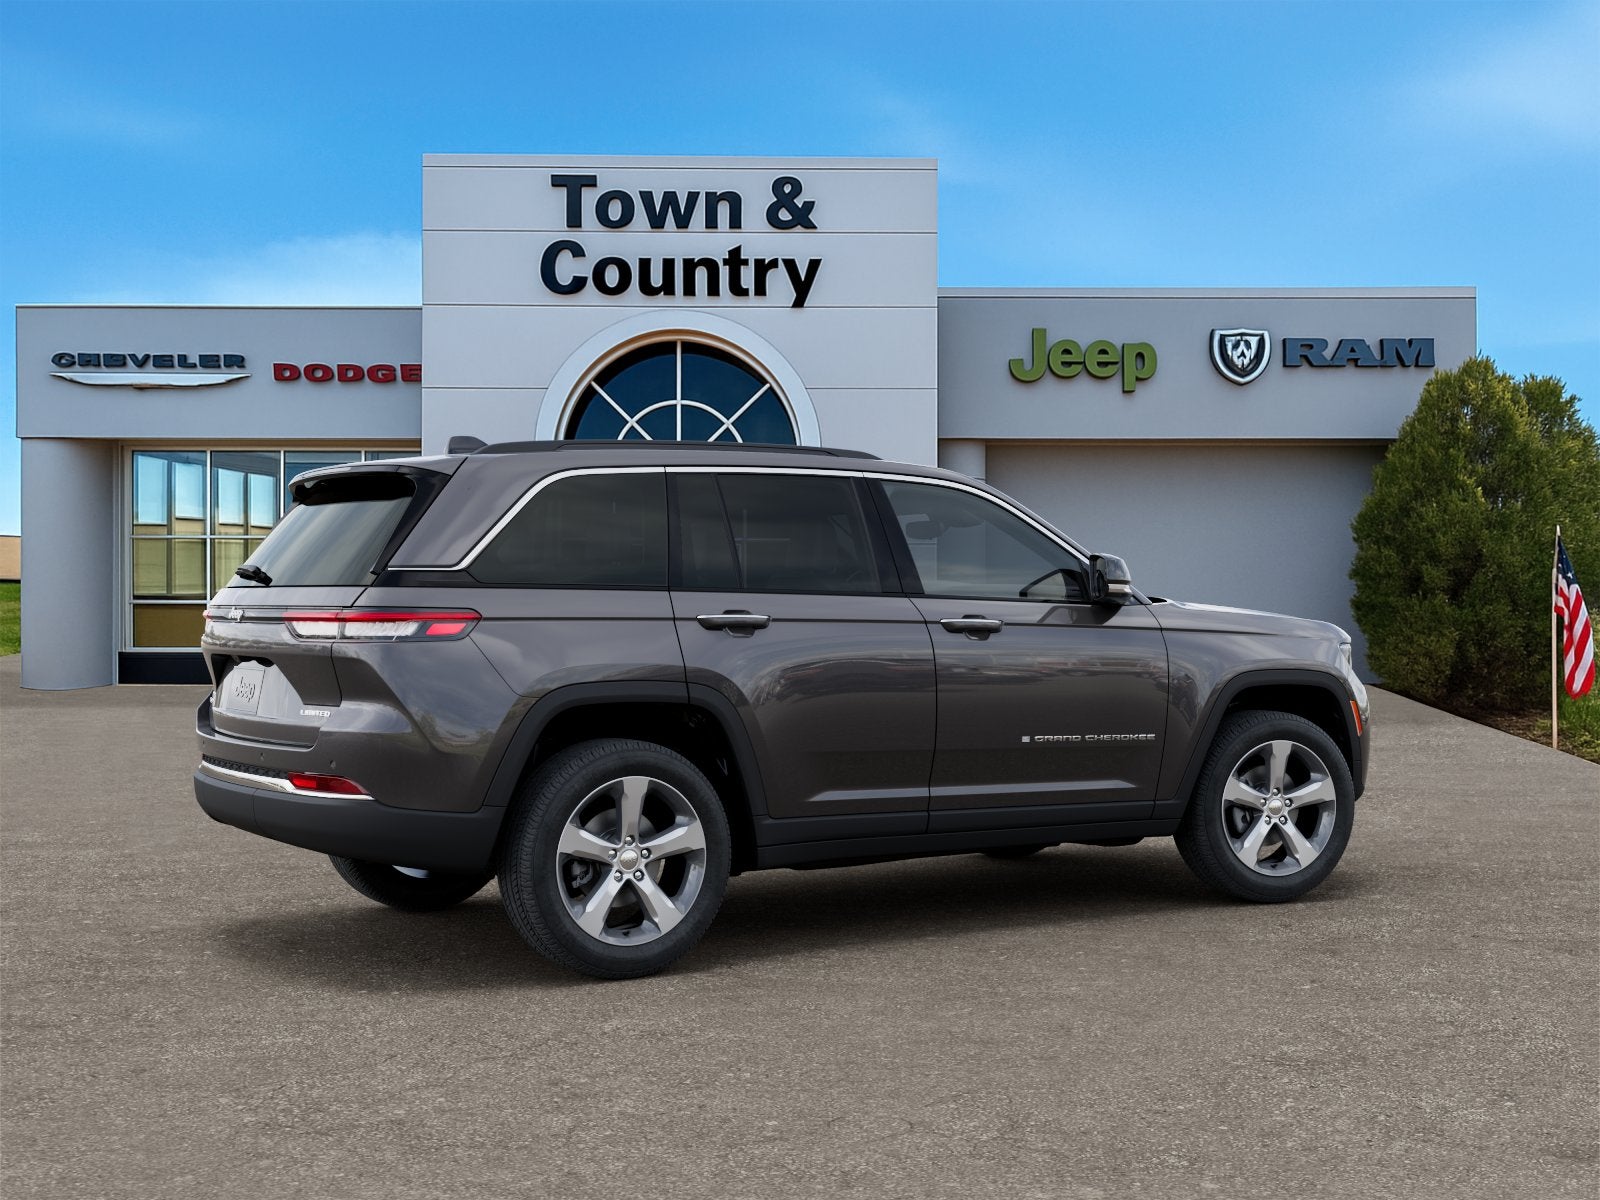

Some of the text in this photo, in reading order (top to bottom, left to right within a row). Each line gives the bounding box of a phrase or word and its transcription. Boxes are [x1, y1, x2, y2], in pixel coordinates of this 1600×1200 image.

[550, 174, 817, 229] Town &
[540, 240, 822, 308] Country
[273, 363, 421, 383] DODGE
[1009, 328, 1157, 392] Jeep
[1283, 338, 1435, 368] RAM
[300, 709, 331, 717] LIMITED
